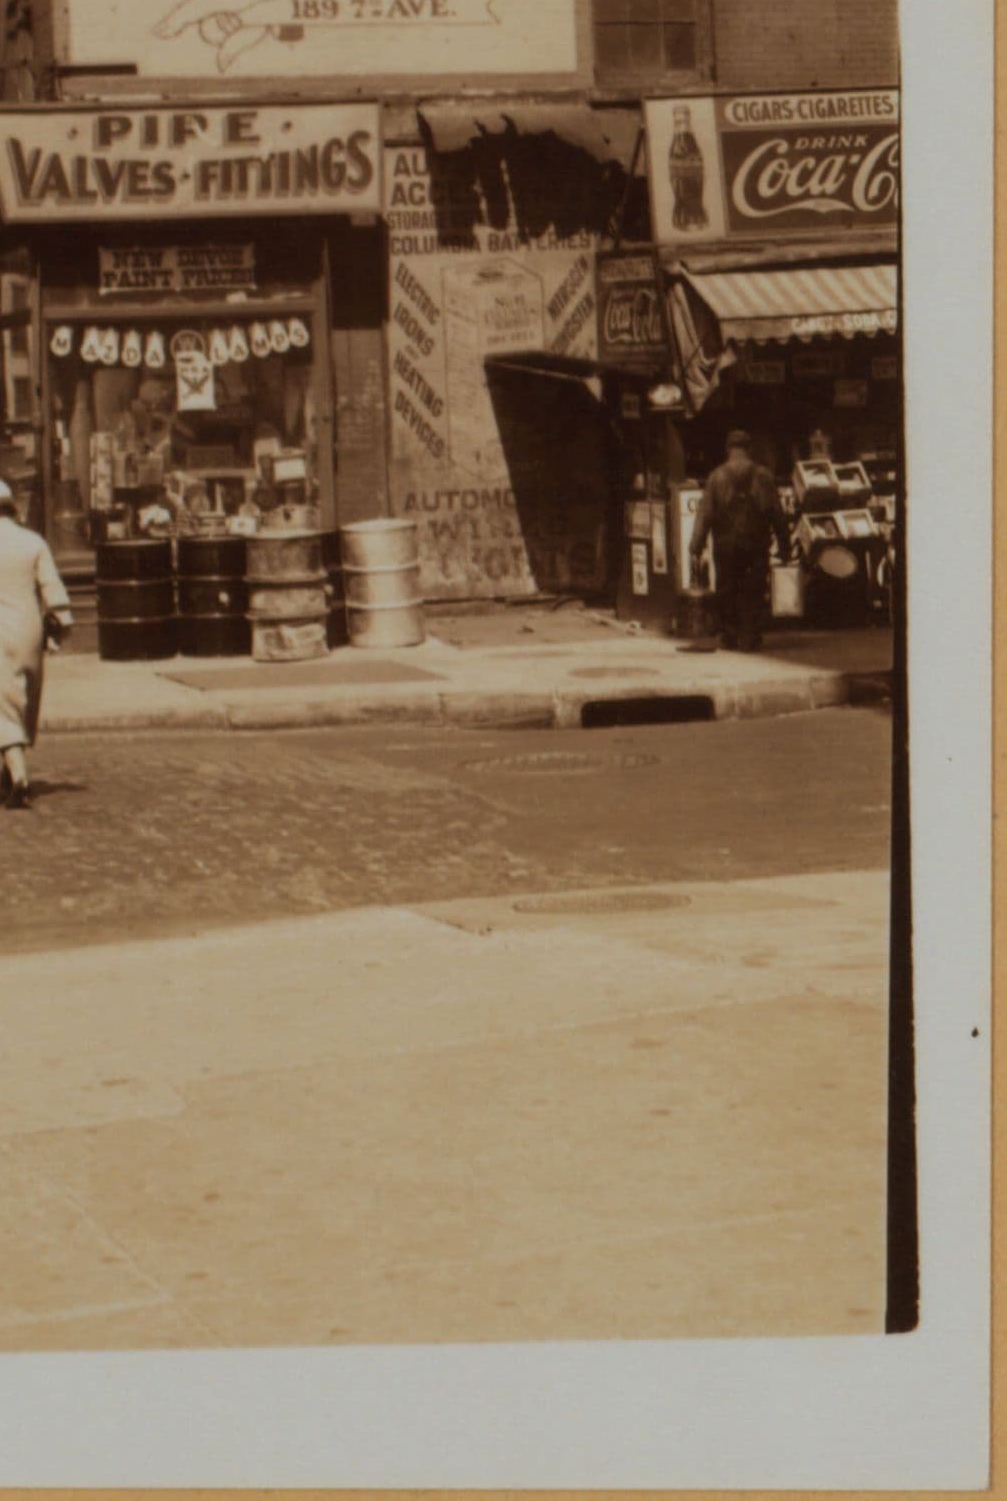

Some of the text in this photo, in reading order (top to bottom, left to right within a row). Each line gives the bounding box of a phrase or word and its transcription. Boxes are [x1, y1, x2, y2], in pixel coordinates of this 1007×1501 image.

[92, 111, 263, 149] PIPE
[732, 96, 894, 122] CIGARS CIGARETTES
[7, 130, 375, 207] VALVES FITTINGS
[796, 134, 869, 150] DRINK
[395, 262, 441, 325] ELECTRIC
[395, 302, 435, 356] IRONS
[395, 353, 444, 418] HEATING
[395, 390, 445, 460] DEVICES
